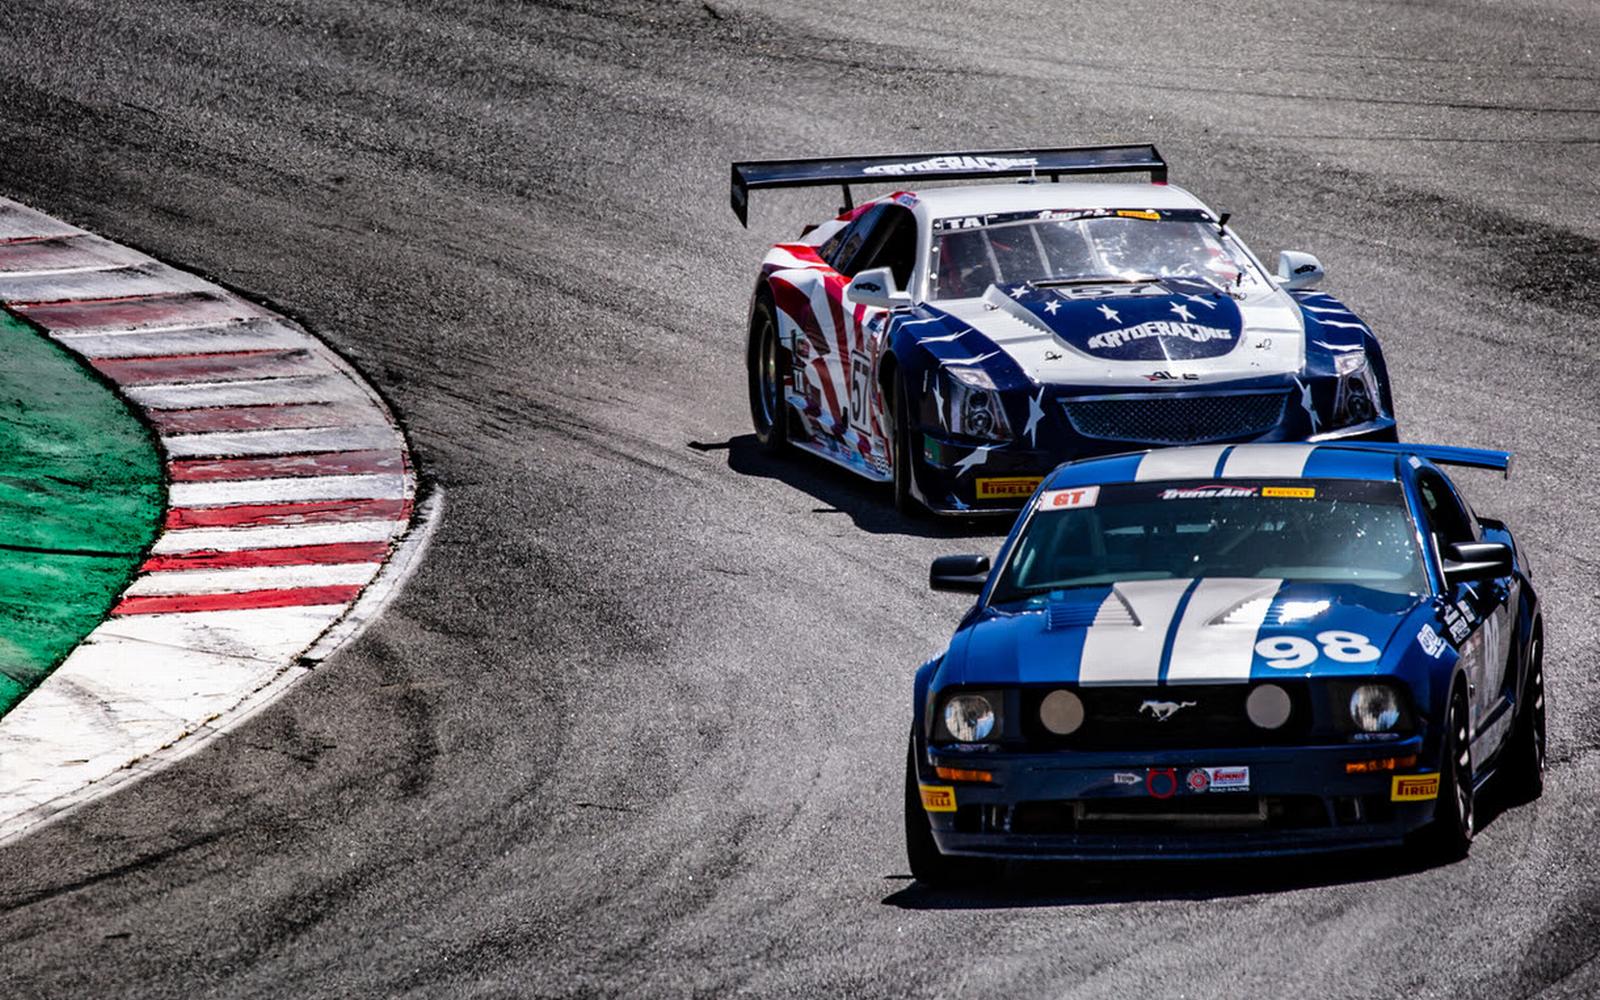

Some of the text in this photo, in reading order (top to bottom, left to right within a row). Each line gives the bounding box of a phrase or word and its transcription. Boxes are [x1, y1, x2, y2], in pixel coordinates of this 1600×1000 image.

[946, 217, 981, 229] TA
[1087, 321, 1232, 349] KRYDERACING
[852, 359, 870, 425] 57
[1053, 491, 1085, 506] GT
[1255, 630, 1381, 669] 98
[1397, 779, 1437, 795] PIRELLI
